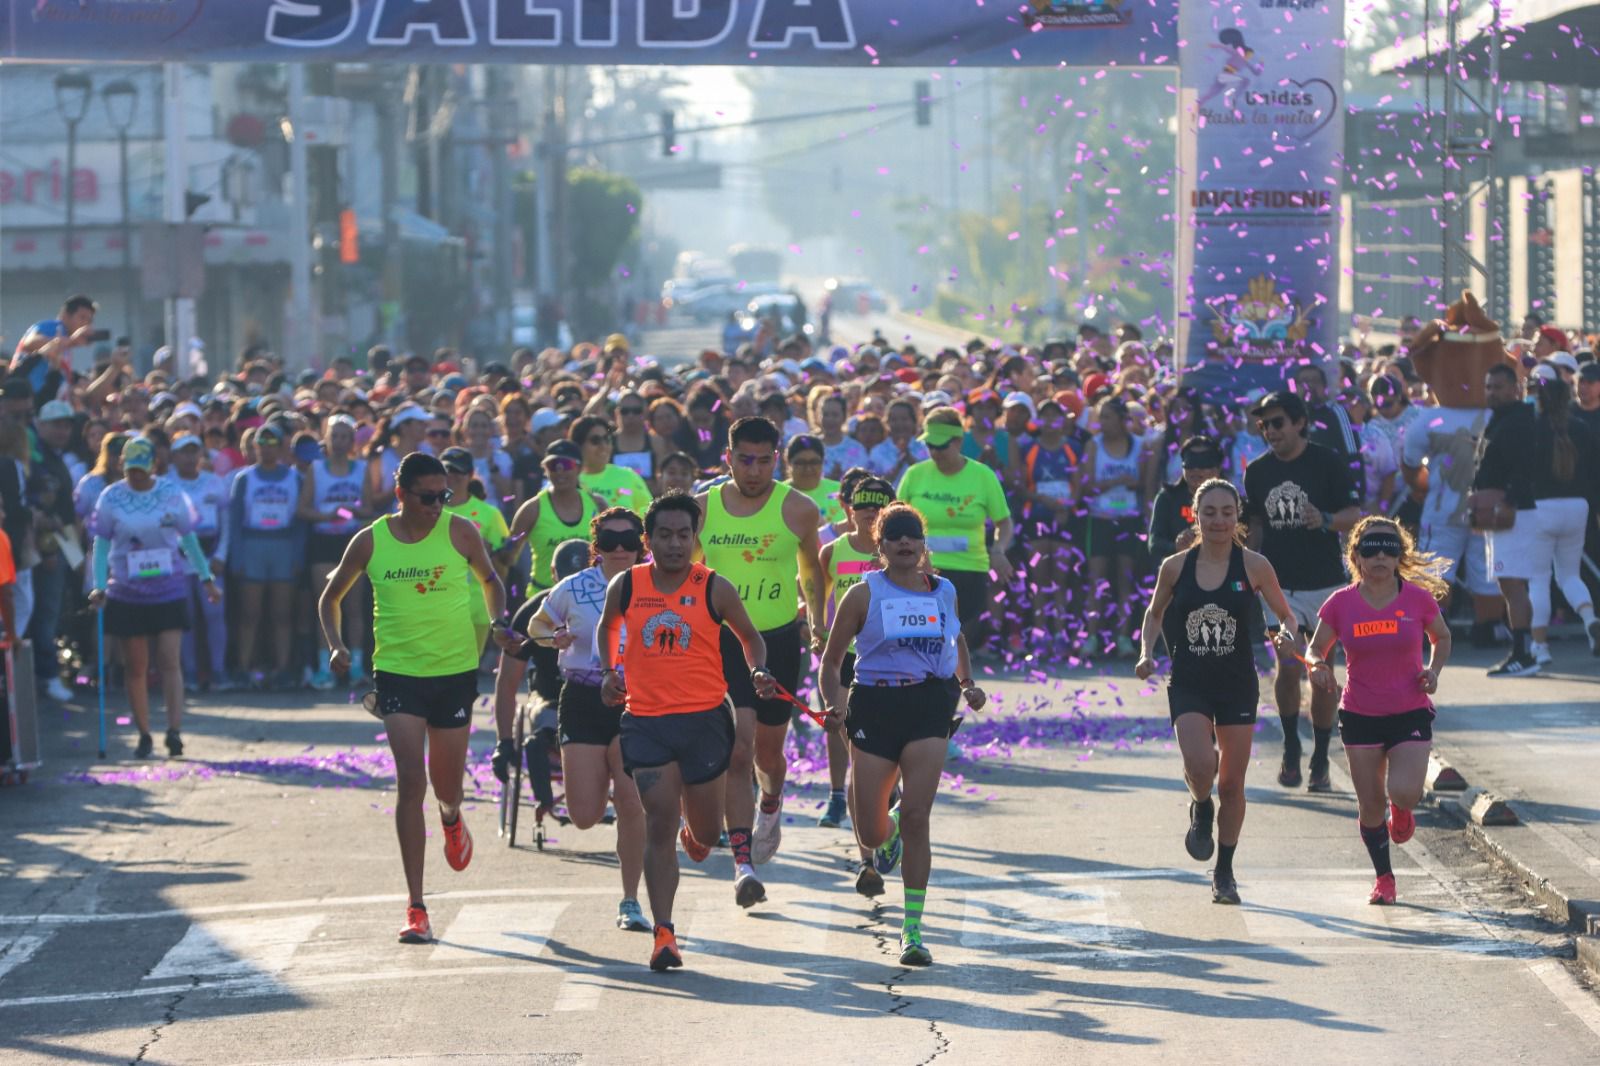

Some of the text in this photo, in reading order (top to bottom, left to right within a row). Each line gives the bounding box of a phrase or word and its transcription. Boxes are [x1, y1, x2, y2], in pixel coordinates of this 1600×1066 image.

[1245, 90, 1313, 106] Unidas
[855, 490, 890, 505] MÉXICO
[707, 533, 759, 546] Achilles
[384, 567, 430, 580] Achilles
[737, 578, 781, 601] uía
[898, 614, 927, 627] 709
